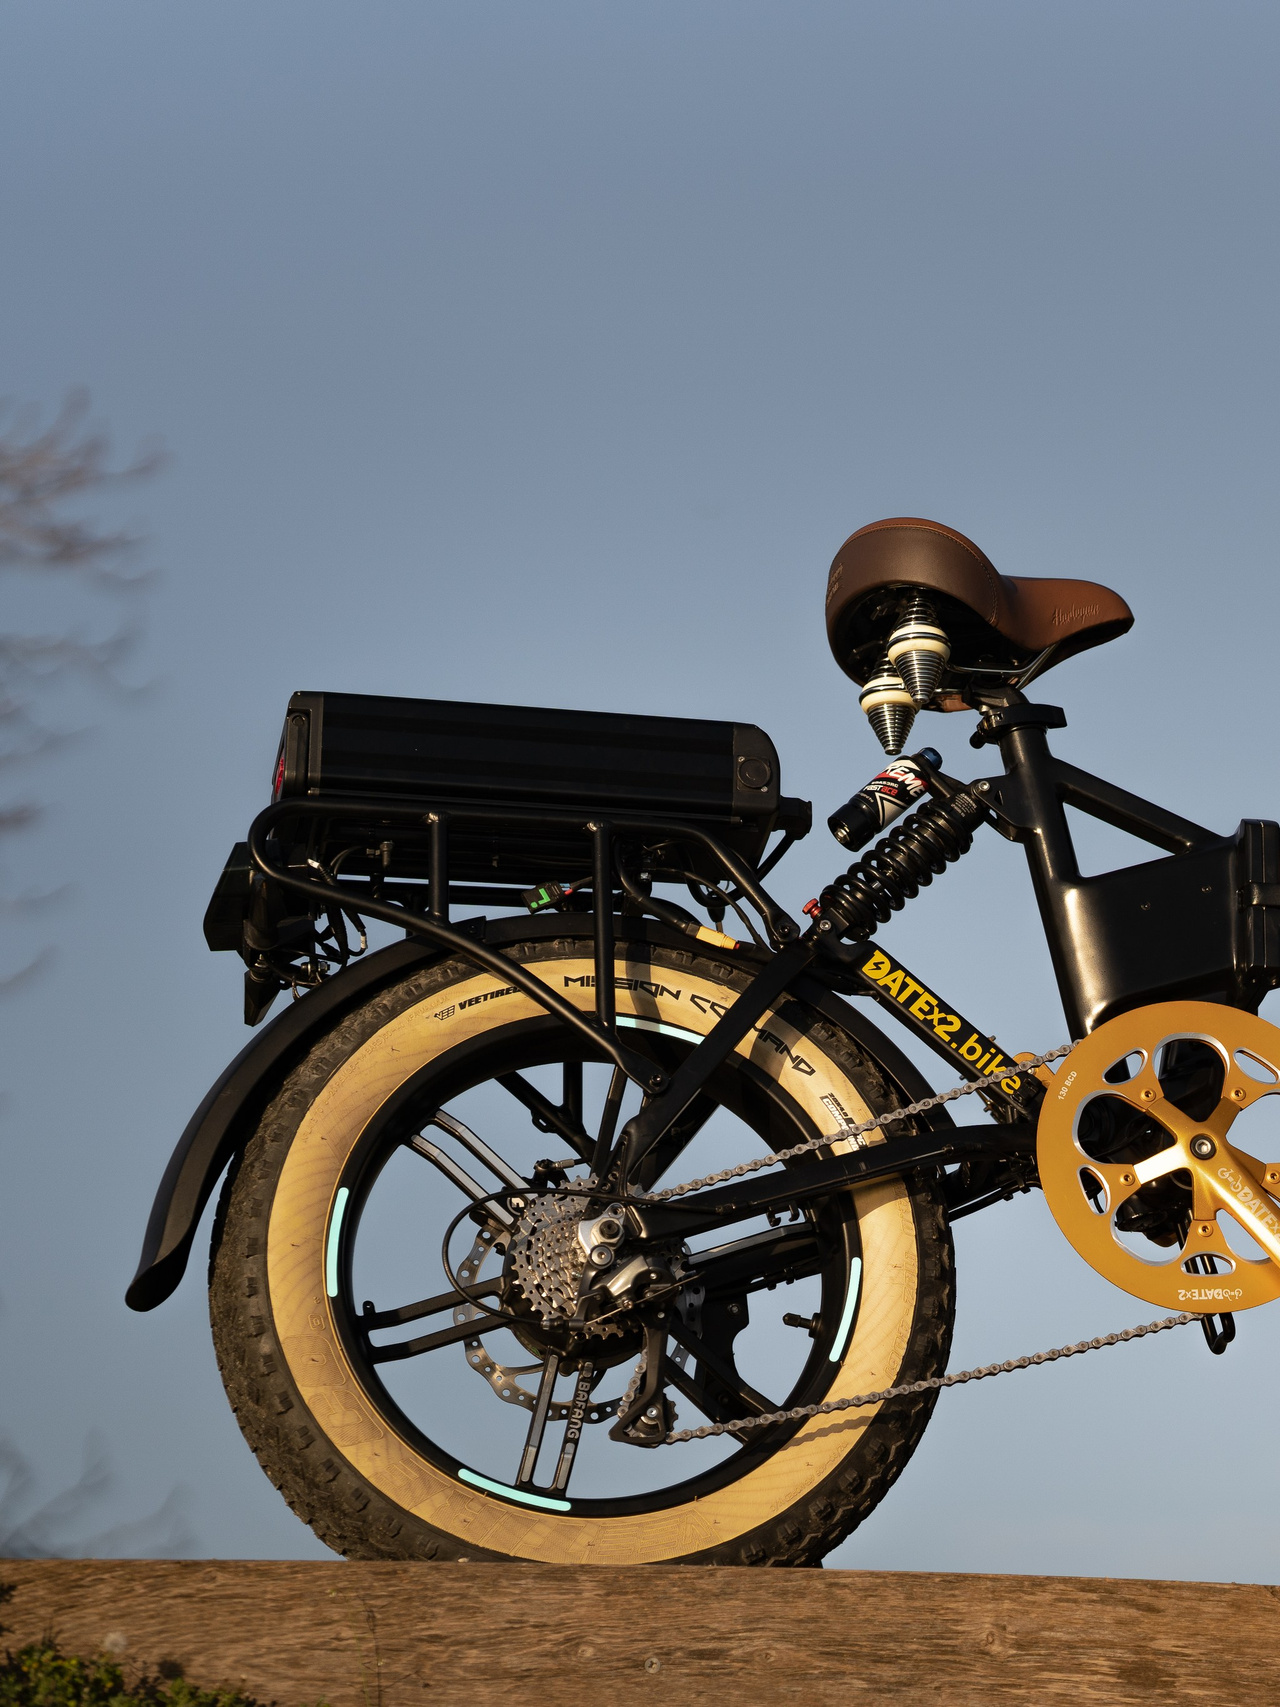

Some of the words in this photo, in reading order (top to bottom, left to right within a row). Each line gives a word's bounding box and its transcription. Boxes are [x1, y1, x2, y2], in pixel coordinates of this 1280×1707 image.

[1057, 1086, 1068, 1100] 130
[1064, 1071, 1077, 1087] BCD
[567, 1382, 590, 1439] BAFANG
